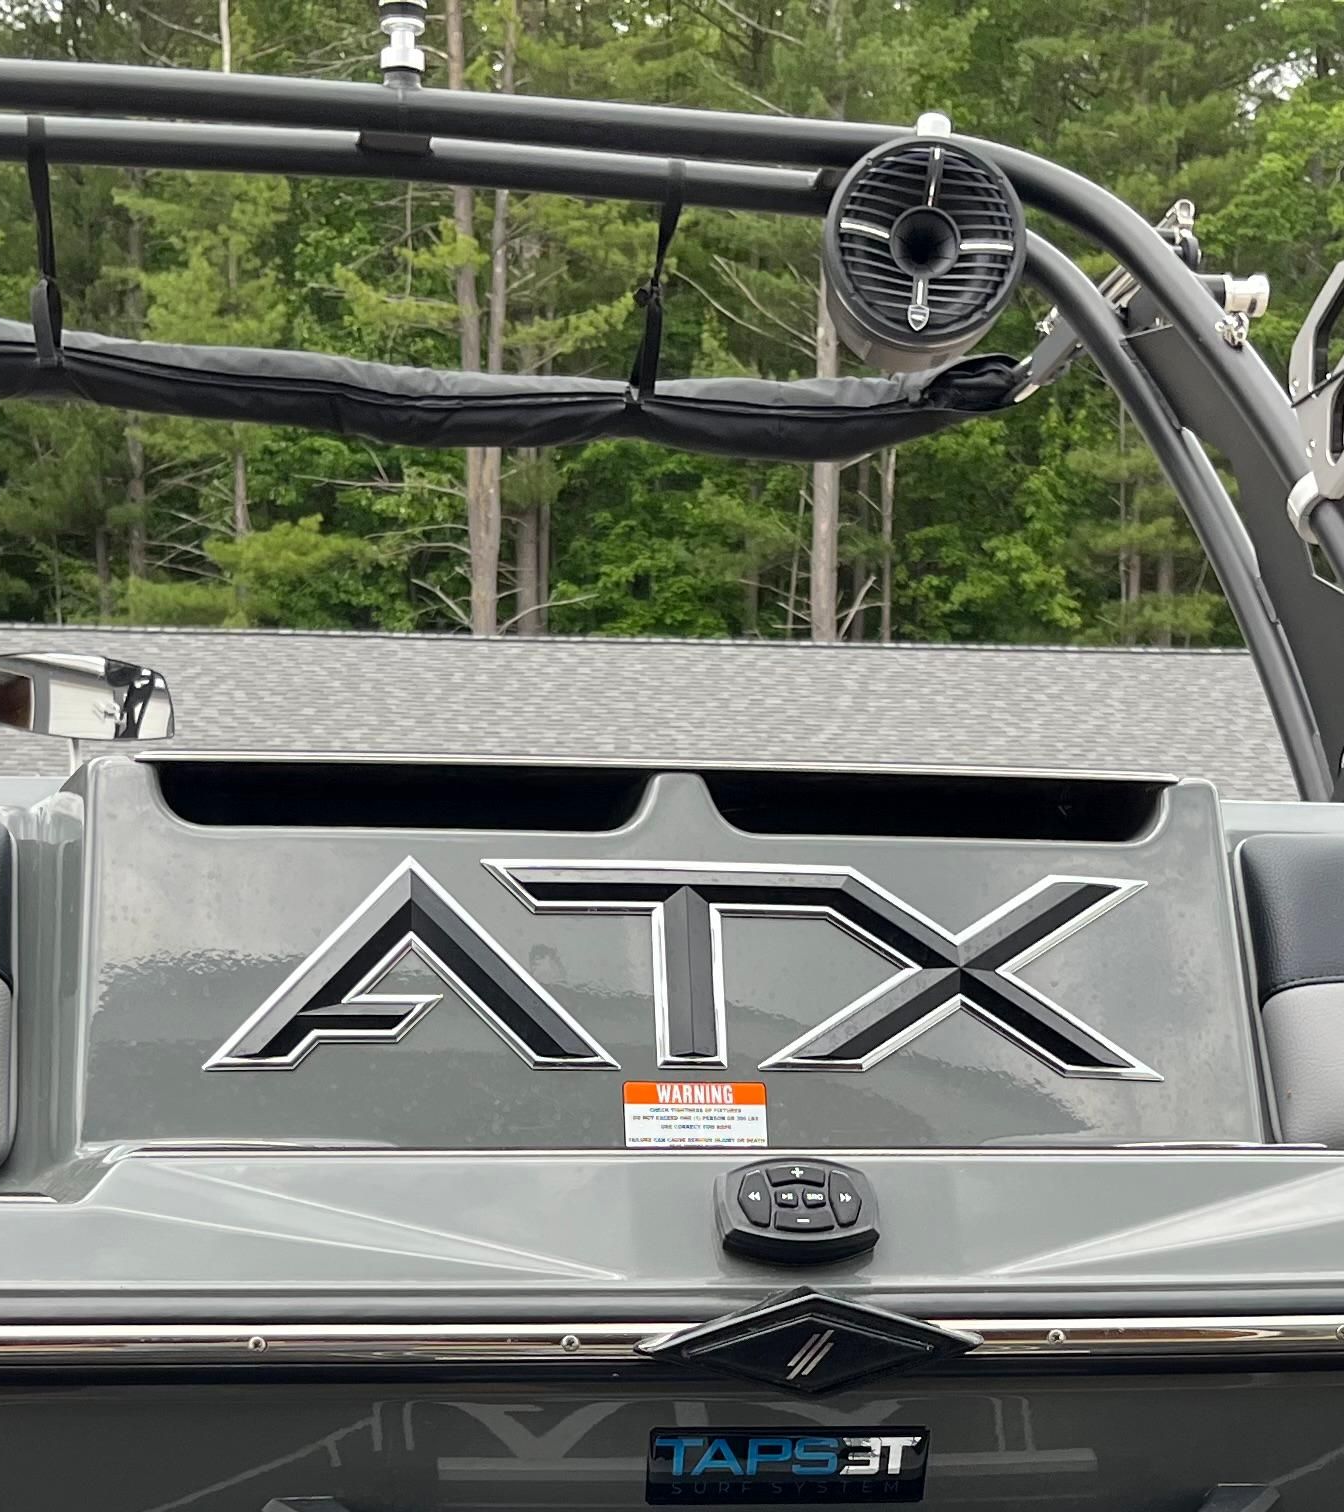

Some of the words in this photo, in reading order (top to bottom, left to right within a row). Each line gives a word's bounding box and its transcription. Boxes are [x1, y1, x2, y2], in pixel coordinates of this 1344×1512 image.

[201, 855, 1166, 1082] ATX
[656, 1083, 734, 1104] WARNING
[671, 1480, 753, 1495] SURF
[771, 1479, 900, 1494] SYSTEM
